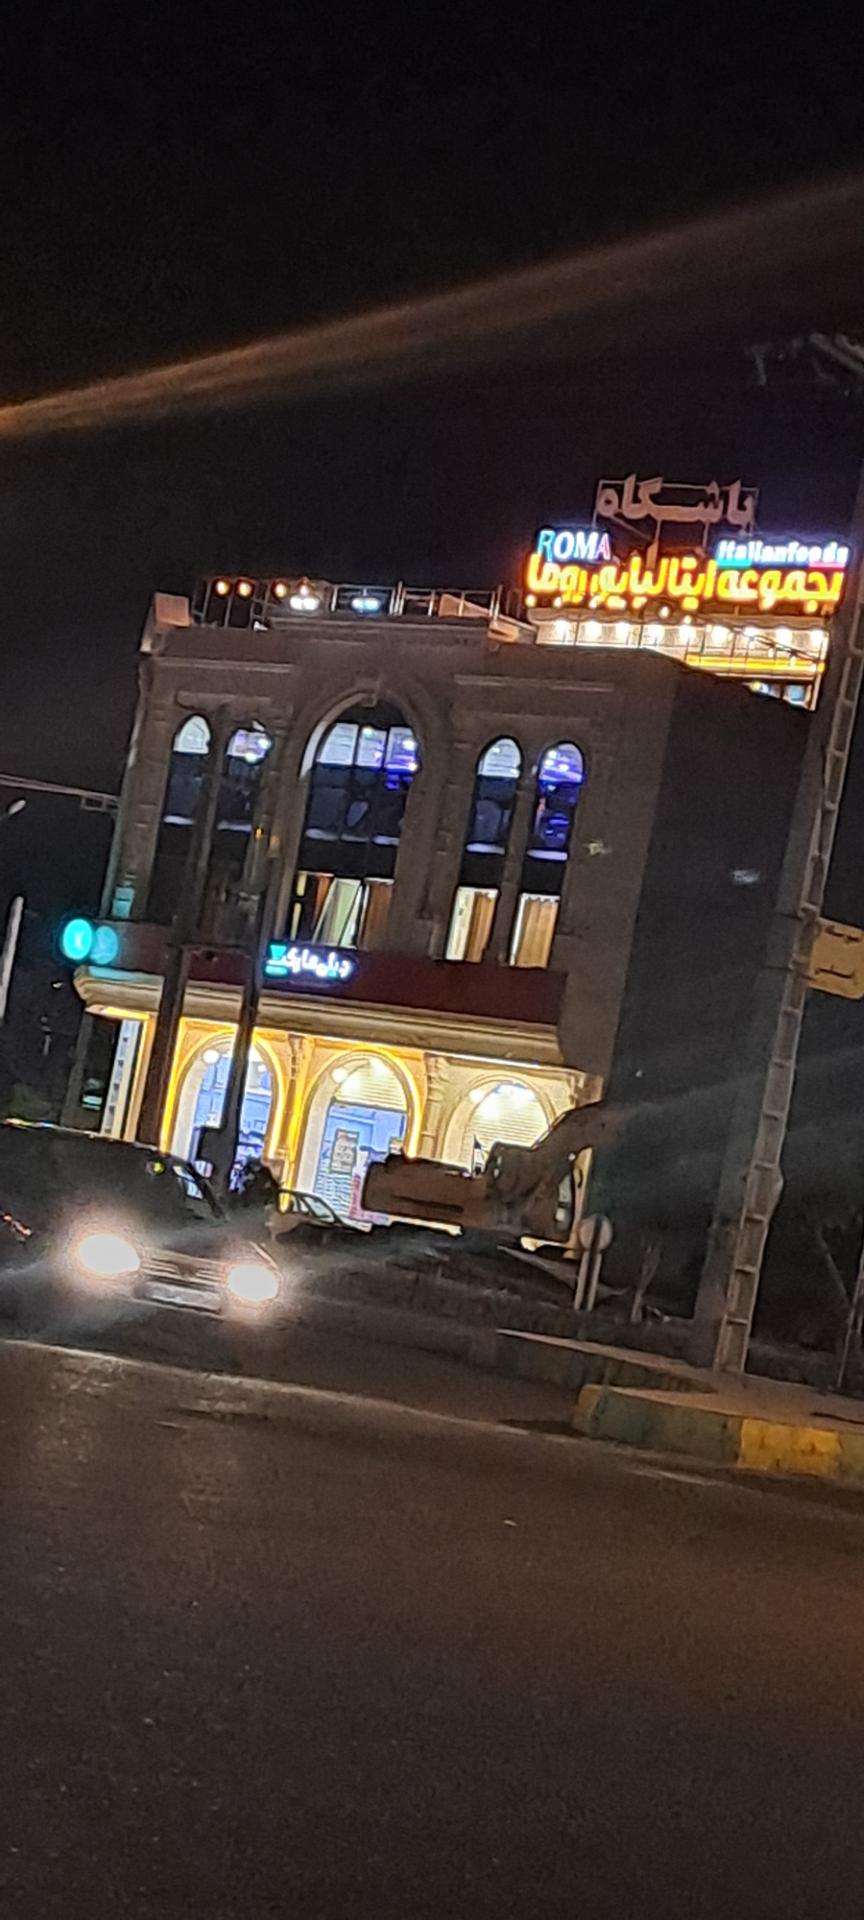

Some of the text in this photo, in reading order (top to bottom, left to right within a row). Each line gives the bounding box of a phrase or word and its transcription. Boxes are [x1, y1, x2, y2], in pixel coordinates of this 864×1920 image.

[598, 474, 755, 533] باشگاه
[537, 530, 612, 561] ROMA
[527, 553, 588, 603] روما
